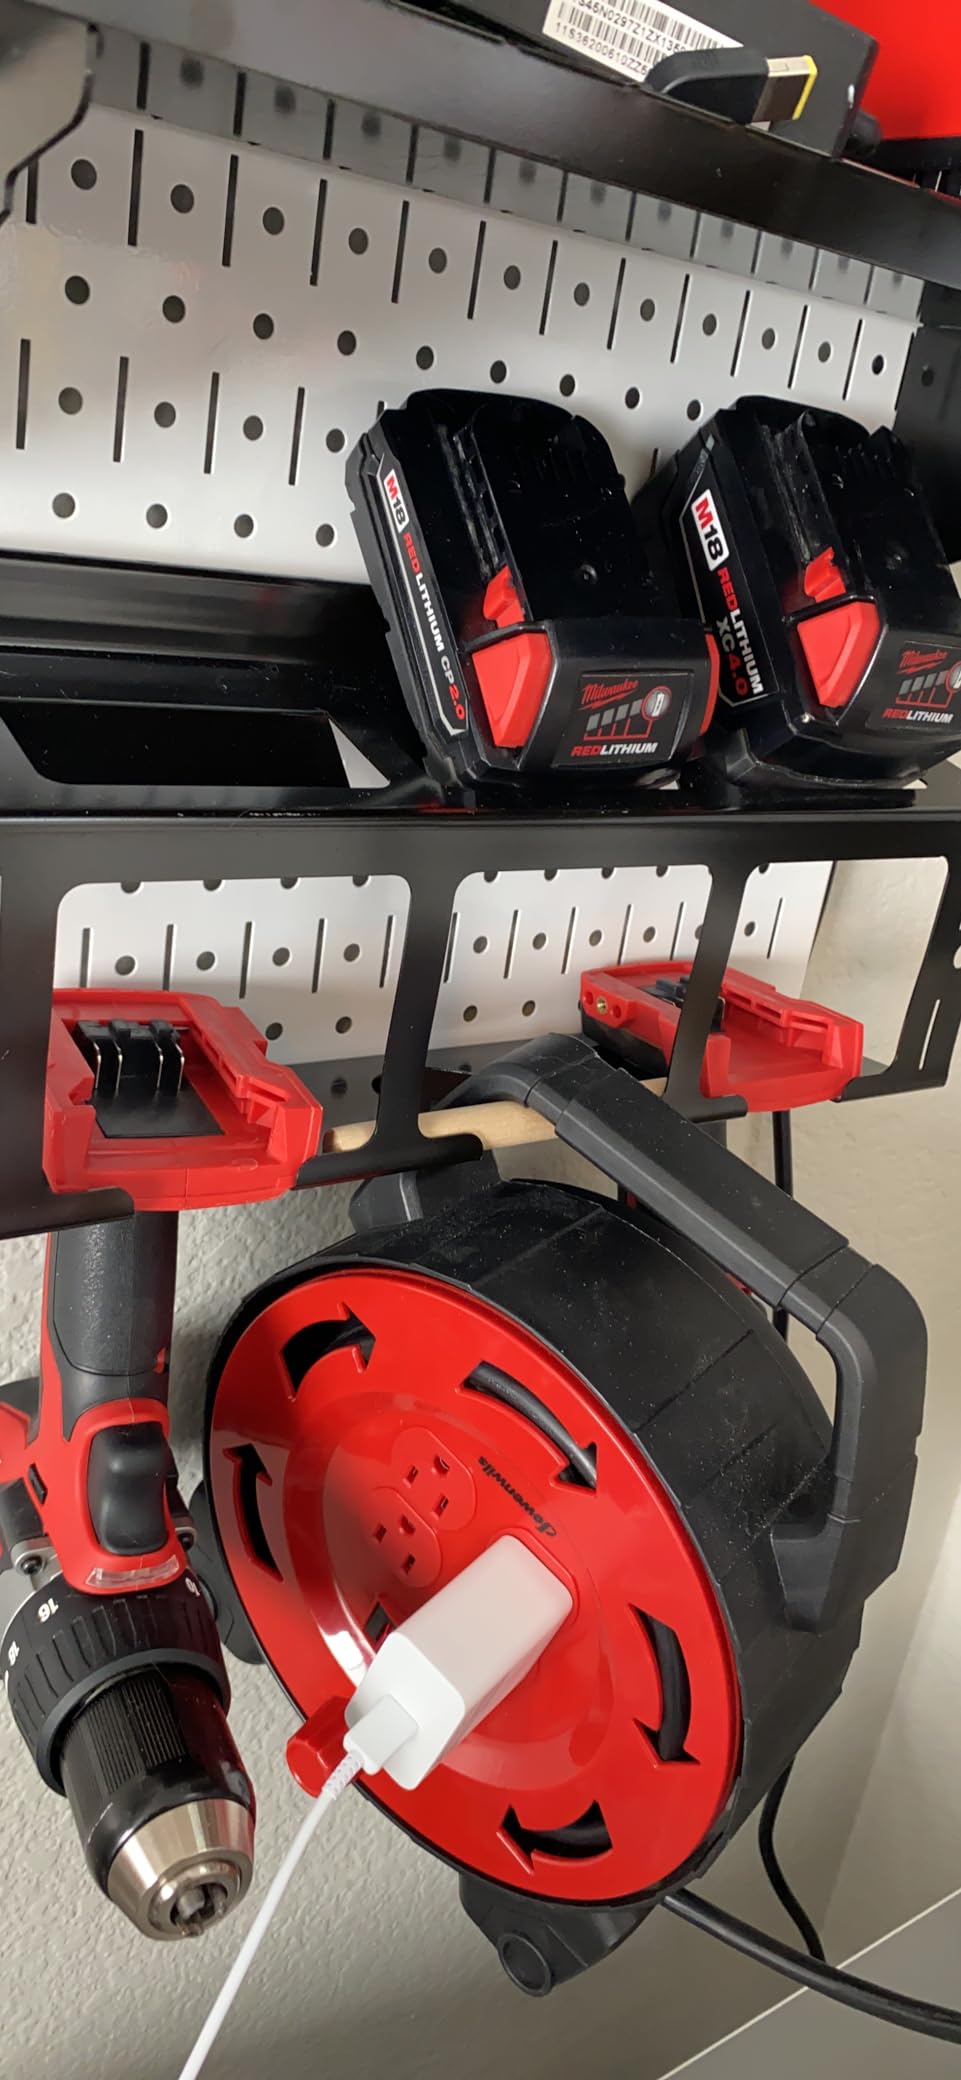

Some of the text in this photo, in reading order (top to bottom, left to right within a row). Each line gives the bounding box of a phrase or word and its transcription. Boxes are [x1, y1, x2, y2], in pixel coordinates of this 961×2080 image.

[386, 474, 406, 527] M18
[695, 497, 724, 562] M18
[581, 678, 639, 706] Milwaukee
[570, 742, 658, 757] REDLITHIUM
[37, 1597, 60, 1624] 16
